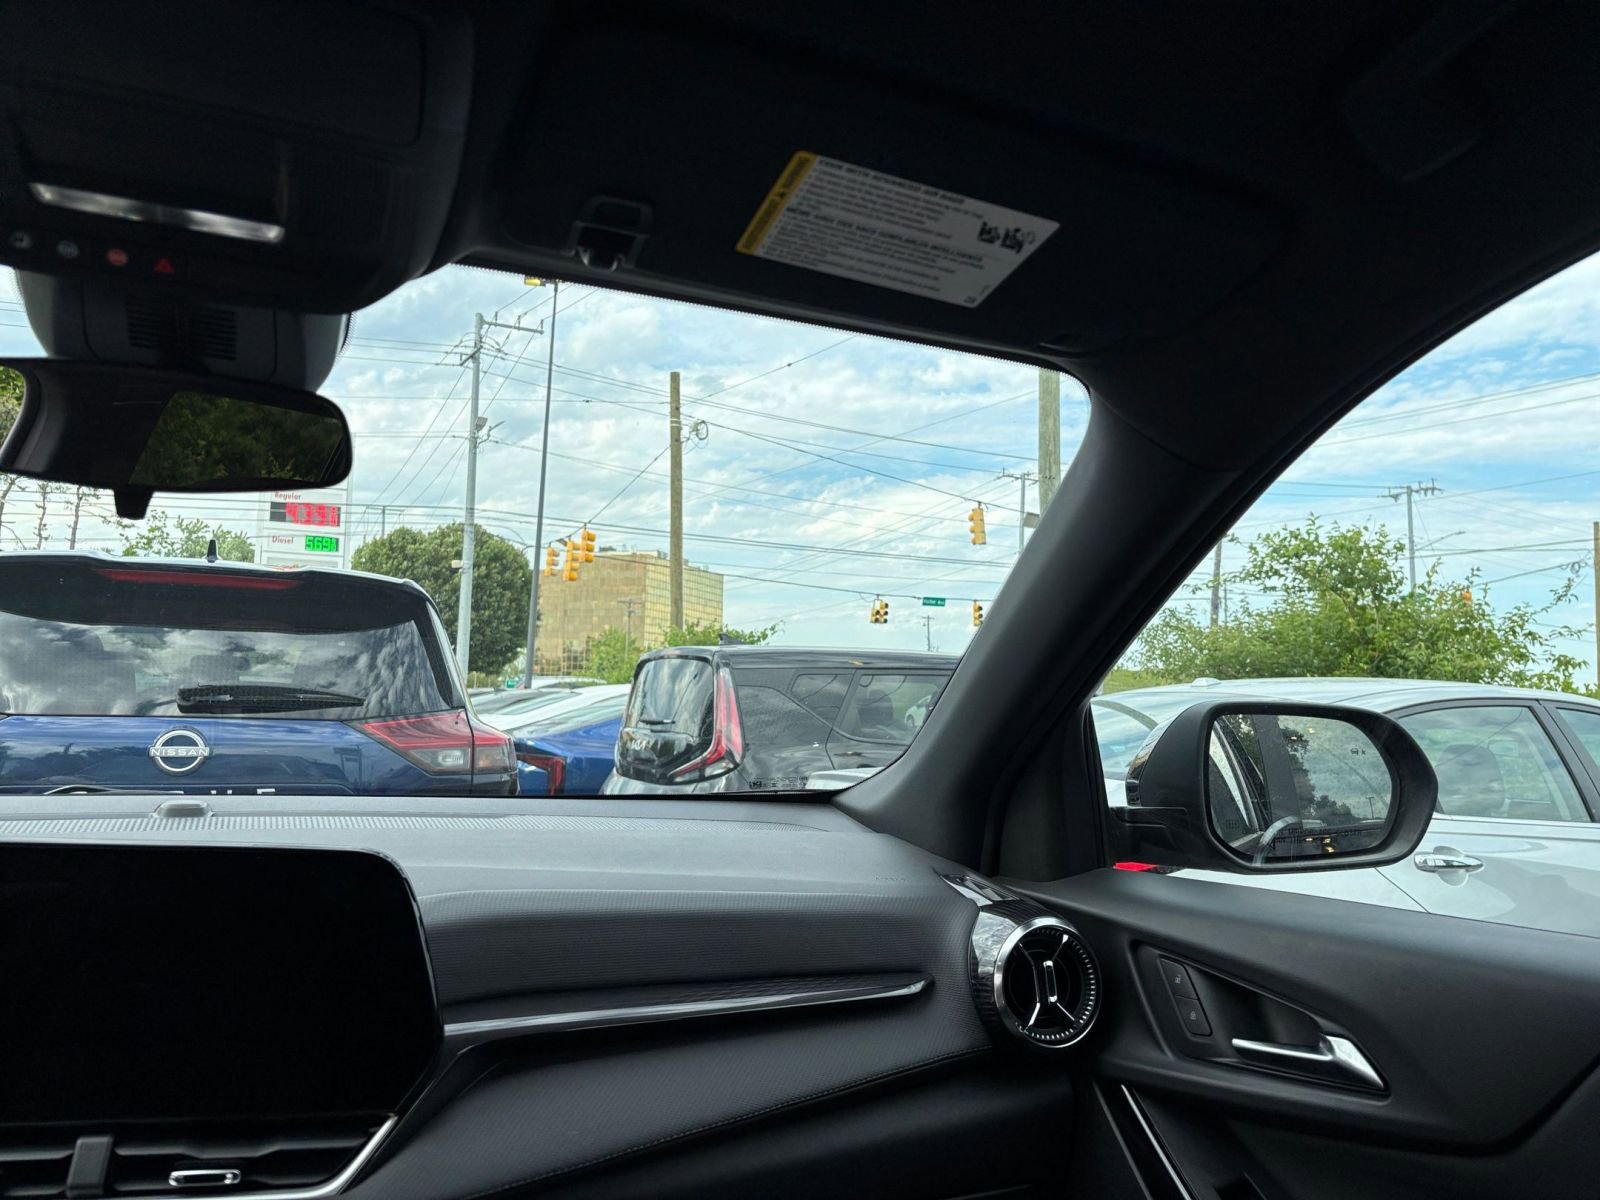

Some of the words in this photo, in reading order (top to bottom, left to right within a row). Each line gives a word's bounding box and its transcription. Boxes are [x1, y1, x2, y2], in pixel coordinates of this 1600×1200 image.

[274, 491, 301, 500] Regular
[272, 536, 294, 544] Diesel
[151, 748, 208, 756] NISSAN
